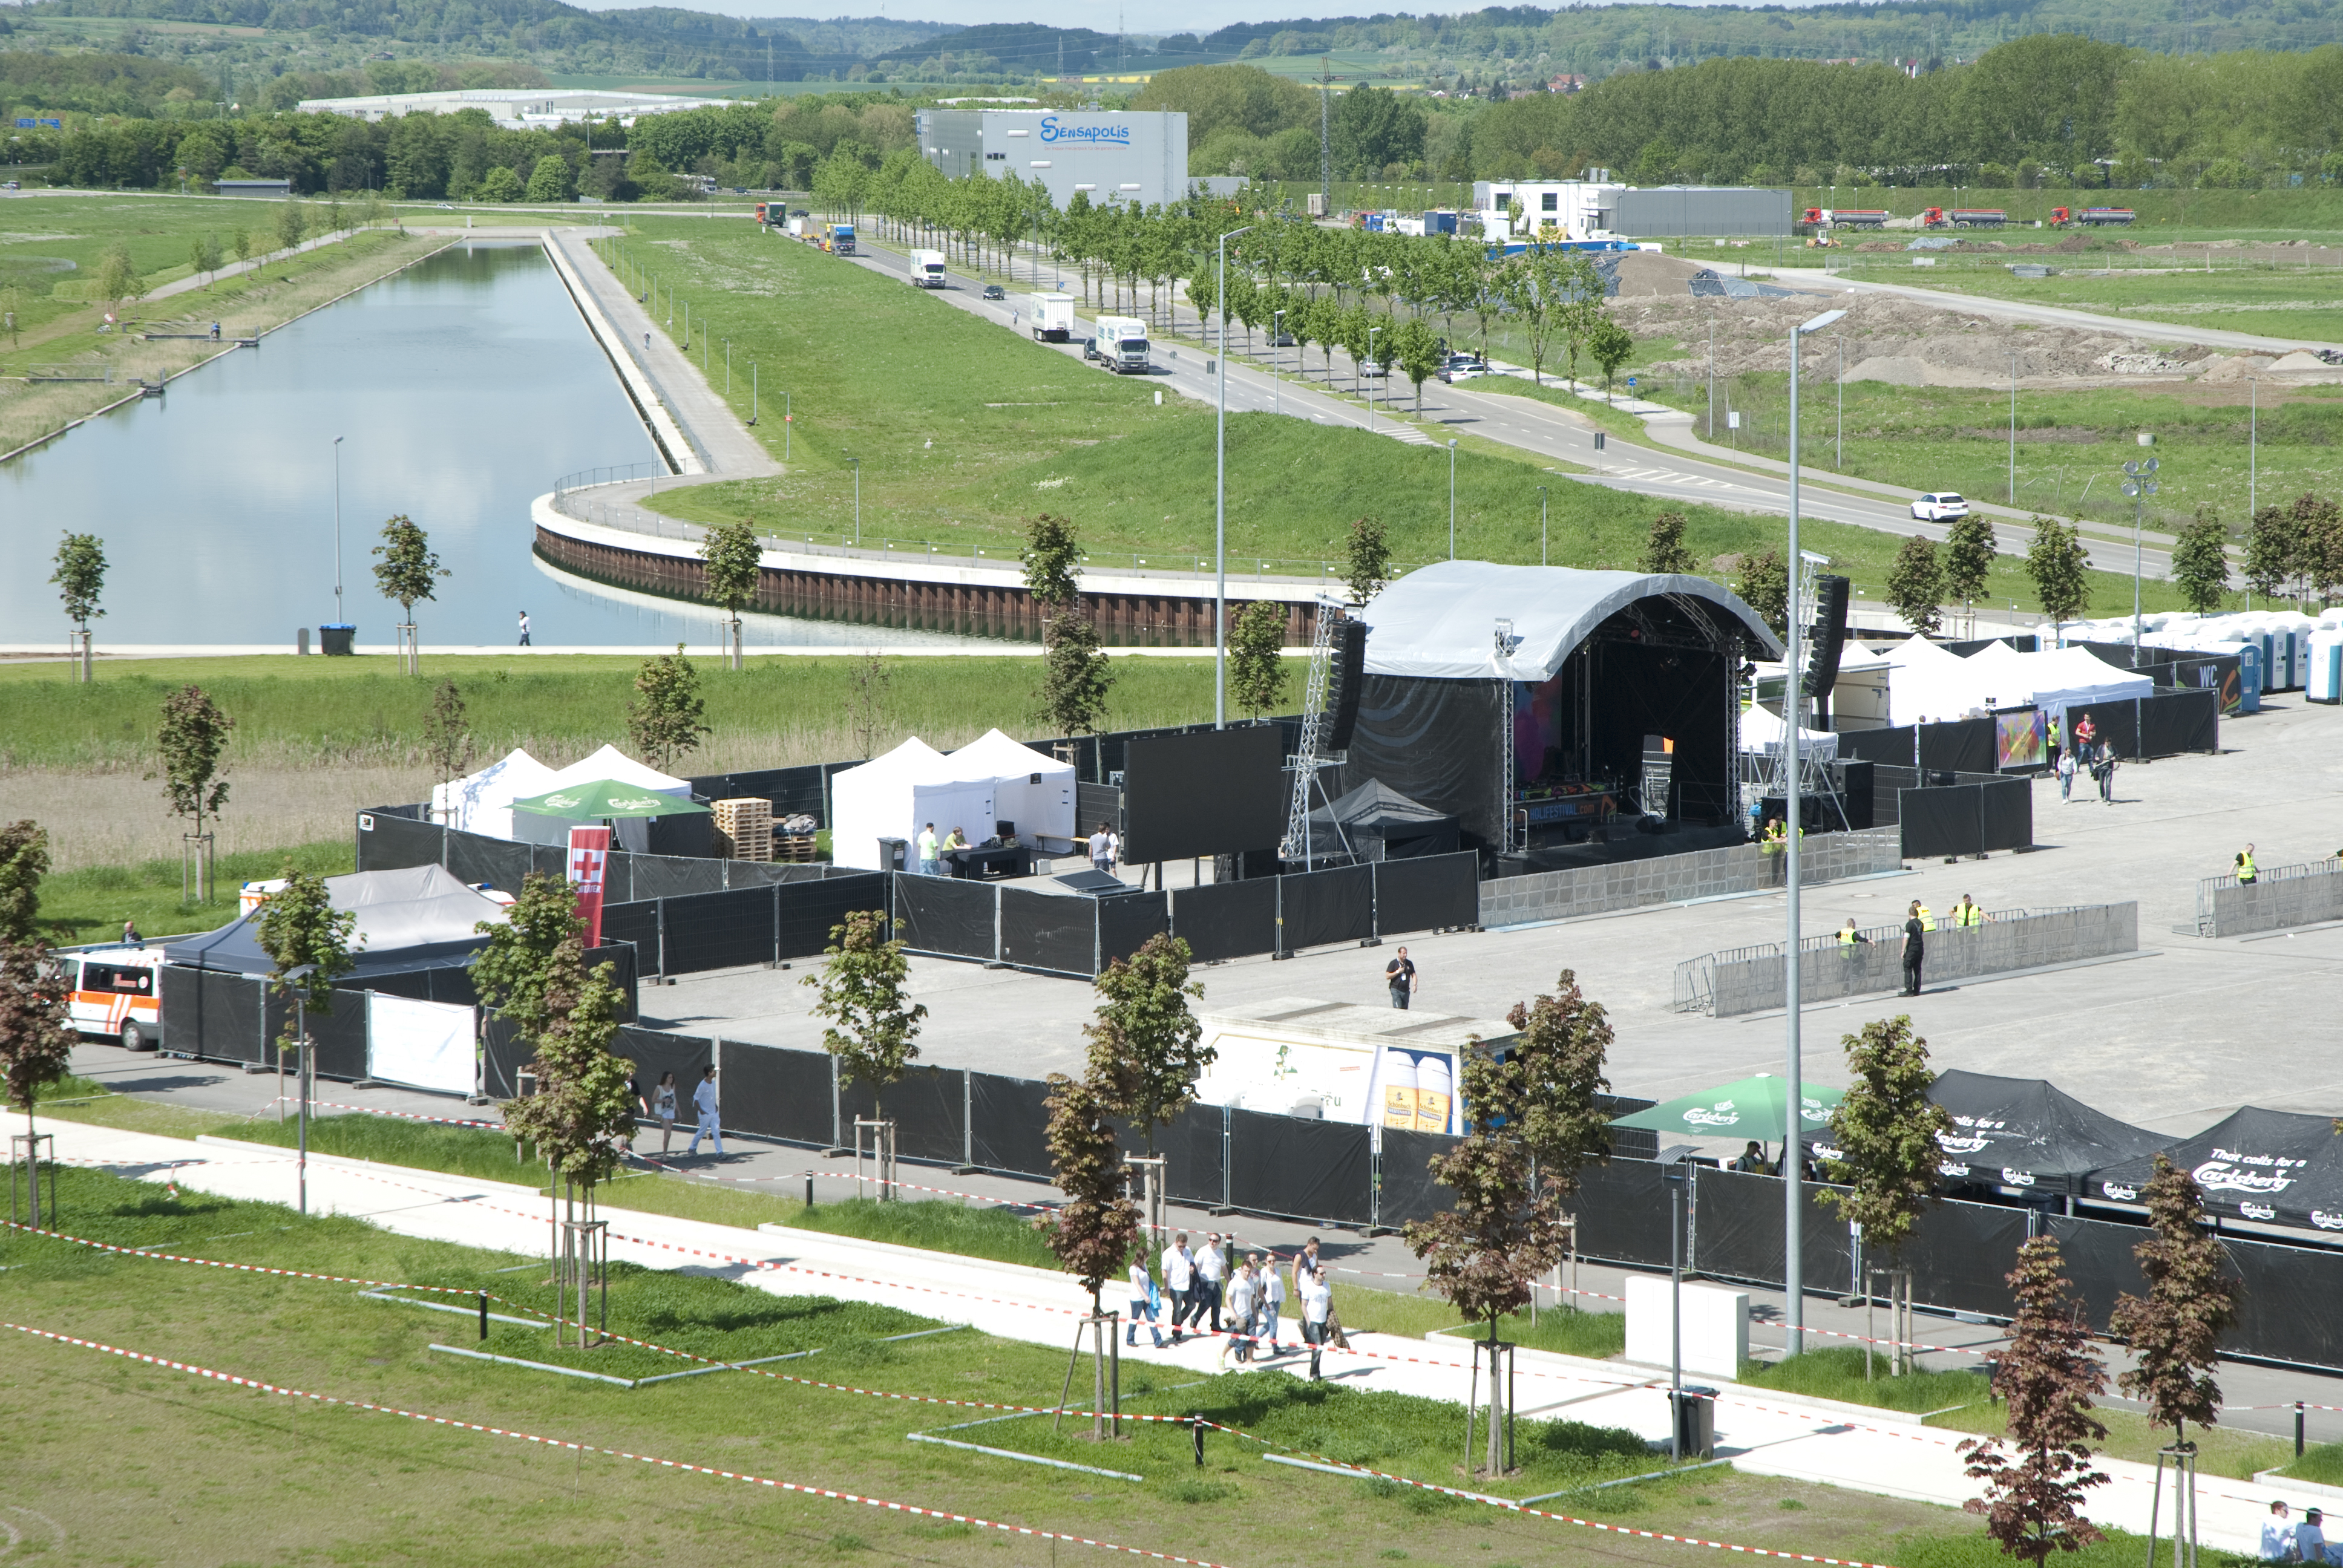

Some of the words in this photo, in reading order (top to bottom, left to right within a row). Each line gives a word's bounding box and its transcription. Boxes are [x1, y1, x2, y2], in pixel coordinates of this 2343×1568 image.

[2199, 664, 2218, 688] WC
[545, 794, 582, 808] Carlsberg
[608, 796, 661, 810] Carlsberg
[1683, 1108, 1740, 1125] Carlsberg
[1952, 1116, 1975, 1127] alls
[1975, 1118, 1994, 1129] for
[1994, 1121, 2005, 1129] a
[1812, 1142, 1844, 1160] Carlsberg
[2210, 1148, 2243, 1162] That
[2242, 1155, 2275, 1166] calls
[2275, 1157, 2296, 1167] for
[2002, 1168, 2036, 1186] Carlsberg
[2192, 1161, 2298, 1194] Carlsberg
[2103, 1181, 2138, 1200] Carlsberg
[2240, 1201, 2277, 1220] Carlsberg
